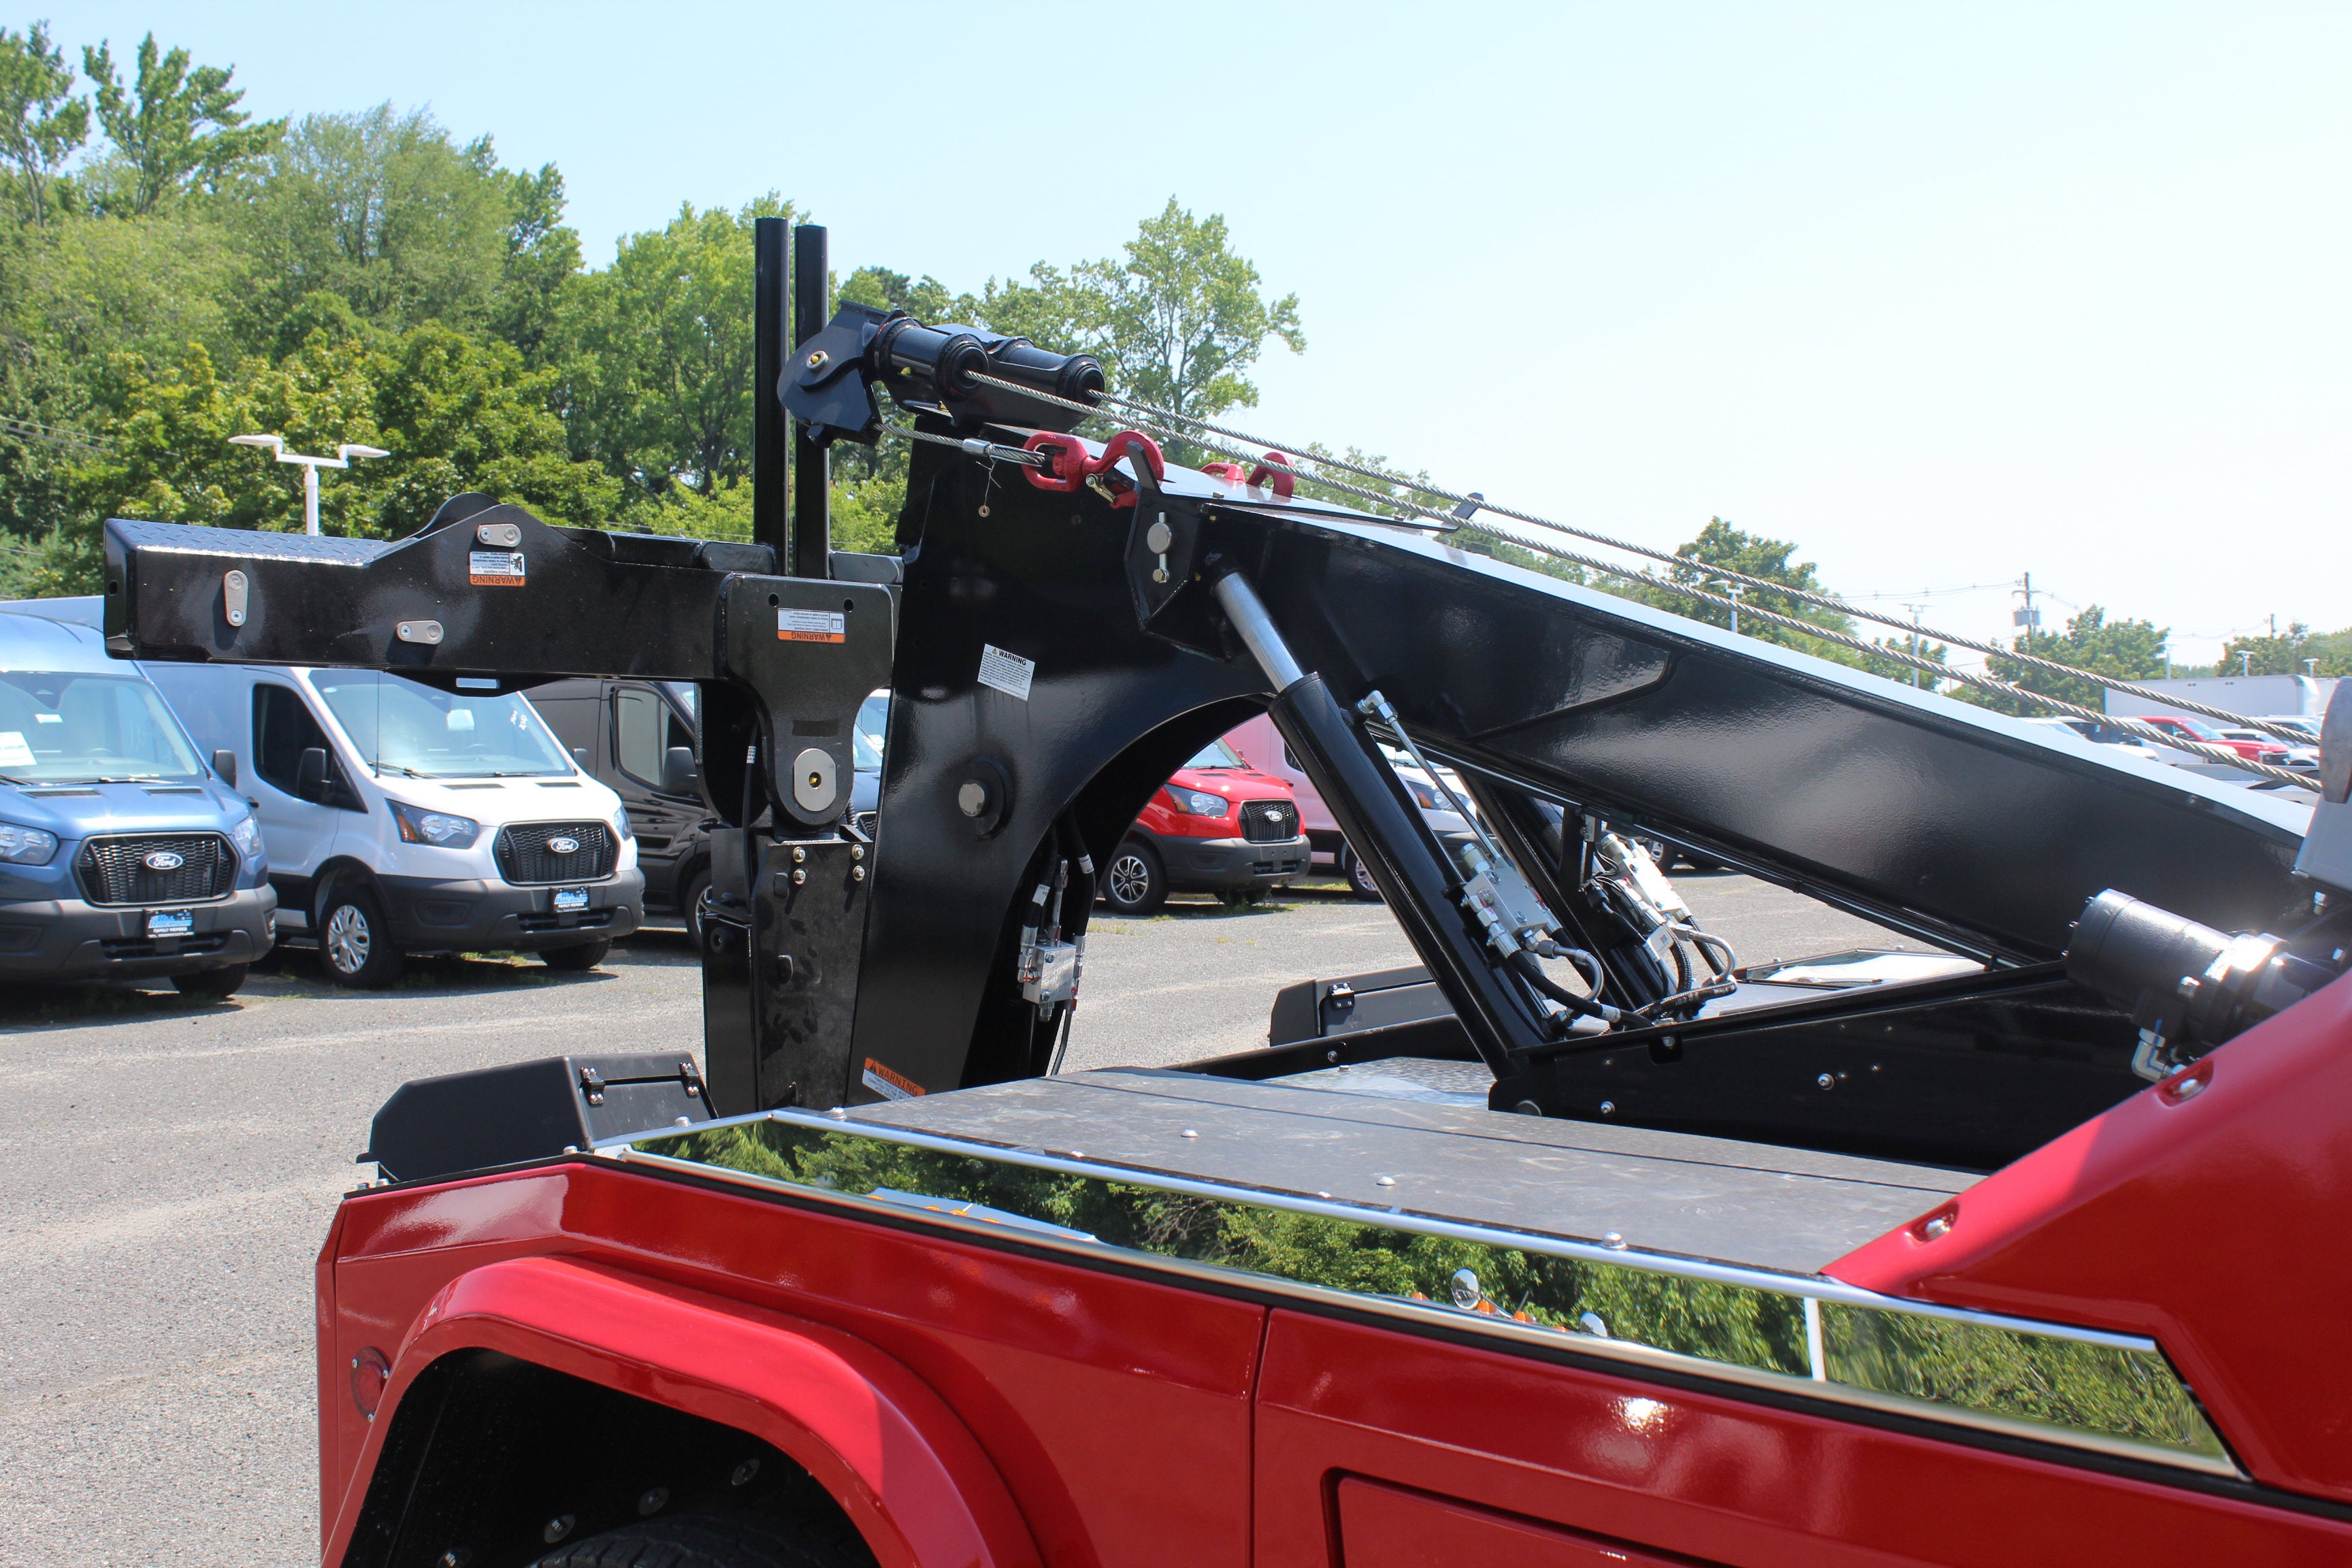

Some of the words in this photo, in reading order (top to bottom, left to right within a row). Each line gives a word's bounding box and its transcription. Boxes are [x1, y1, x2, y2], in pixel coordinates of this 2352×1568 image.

[472, 576, 514, 584] WARNING
[791, 632, 826, 640] WARNING
[998, 649, 1026, 666] WARNING
[879, 1066, 917, 1095] WARNING
